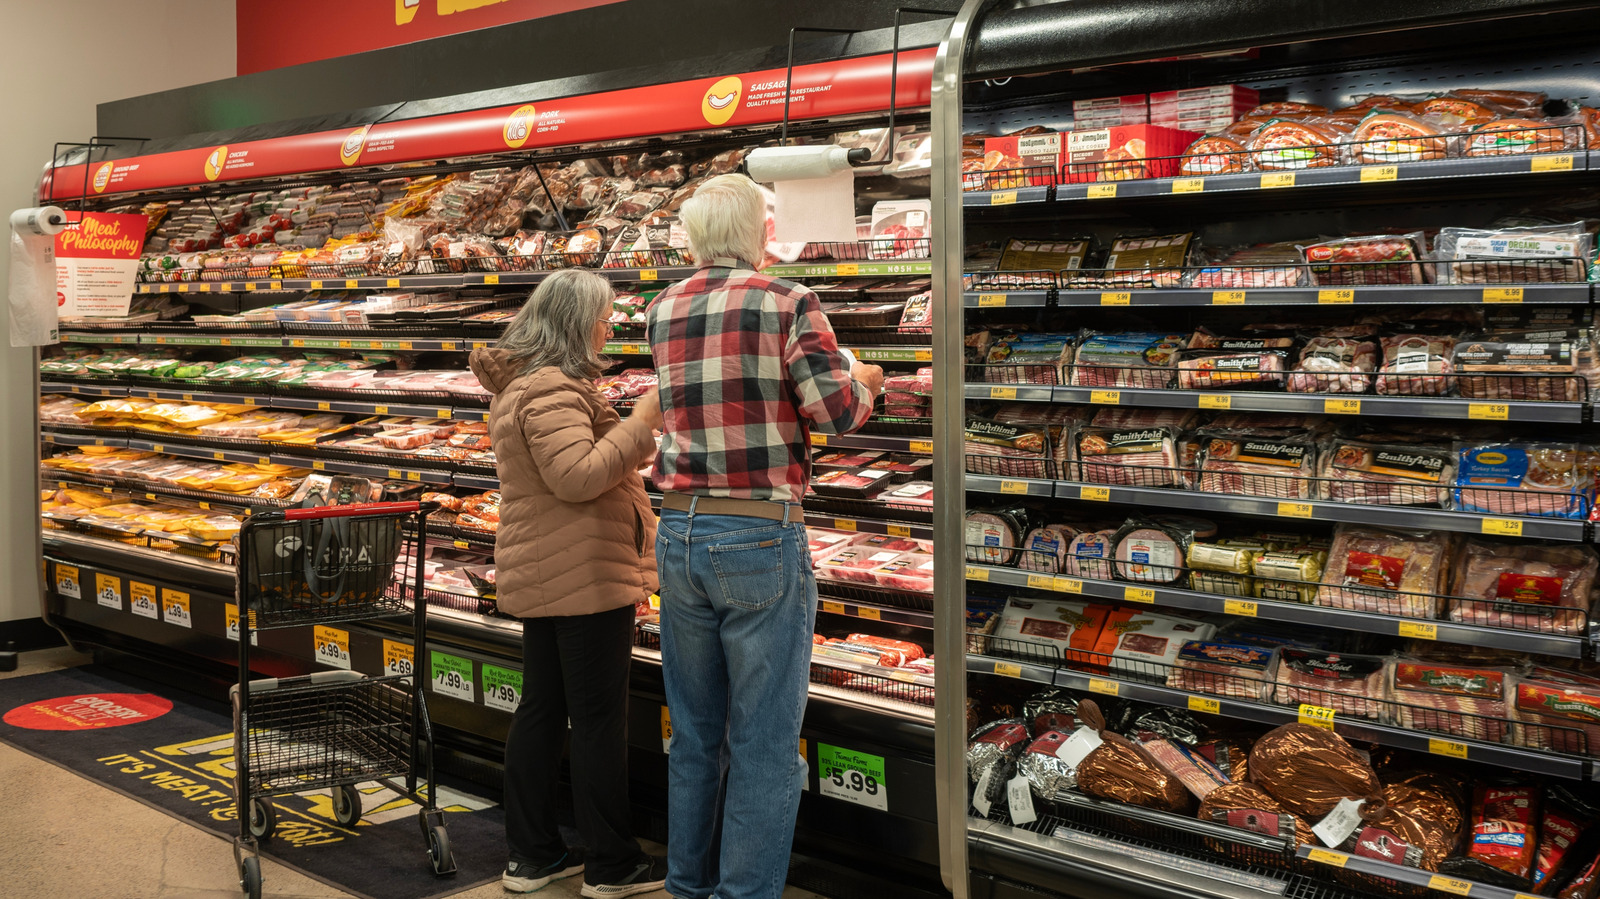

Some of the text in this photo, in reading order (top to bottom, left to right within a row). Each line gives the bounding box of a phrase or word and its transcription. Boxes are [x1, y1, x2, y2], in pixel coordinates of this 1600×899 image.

[763, 91, 780, 99] FRESH
[796, 85, 832, 95] RESTAURANT
[746, 100, 769, 108] QUALITY
[540, 110, 560, 119] PORK
[537, 125, 559, 133] CORN-FED
[228, 150, 249, 159] CHICKEN
[81, 217, 120, 238] Meat
[60, 231, 139, 256] Philosophy
[1508, 240, 1540, 250] ORGANIC
[1313, 250, 1331, 258] Tyson
[805, 267, 827, 275] NOSH
[888, 265, 912, 273] NOSH
[865, 351, 889, 359] NOSH
[1217, 358, 1259, 369] Smithfield
[1112, 431, 1163, 442] Smithfield
[1244, 442, 1304, 455] Smithfield
[1377, 452, 1443, 467] Smithfield
[1554, 703, 1582, 711] SUNRISE
[97, 753, 157, 774] IT'S
[832, 760, 846, 769] LEAN
[846, 764, 868, 774] GROUND
[868, 769, 881, 777] BEEF
[825, 767, 878, 796] $5.99
